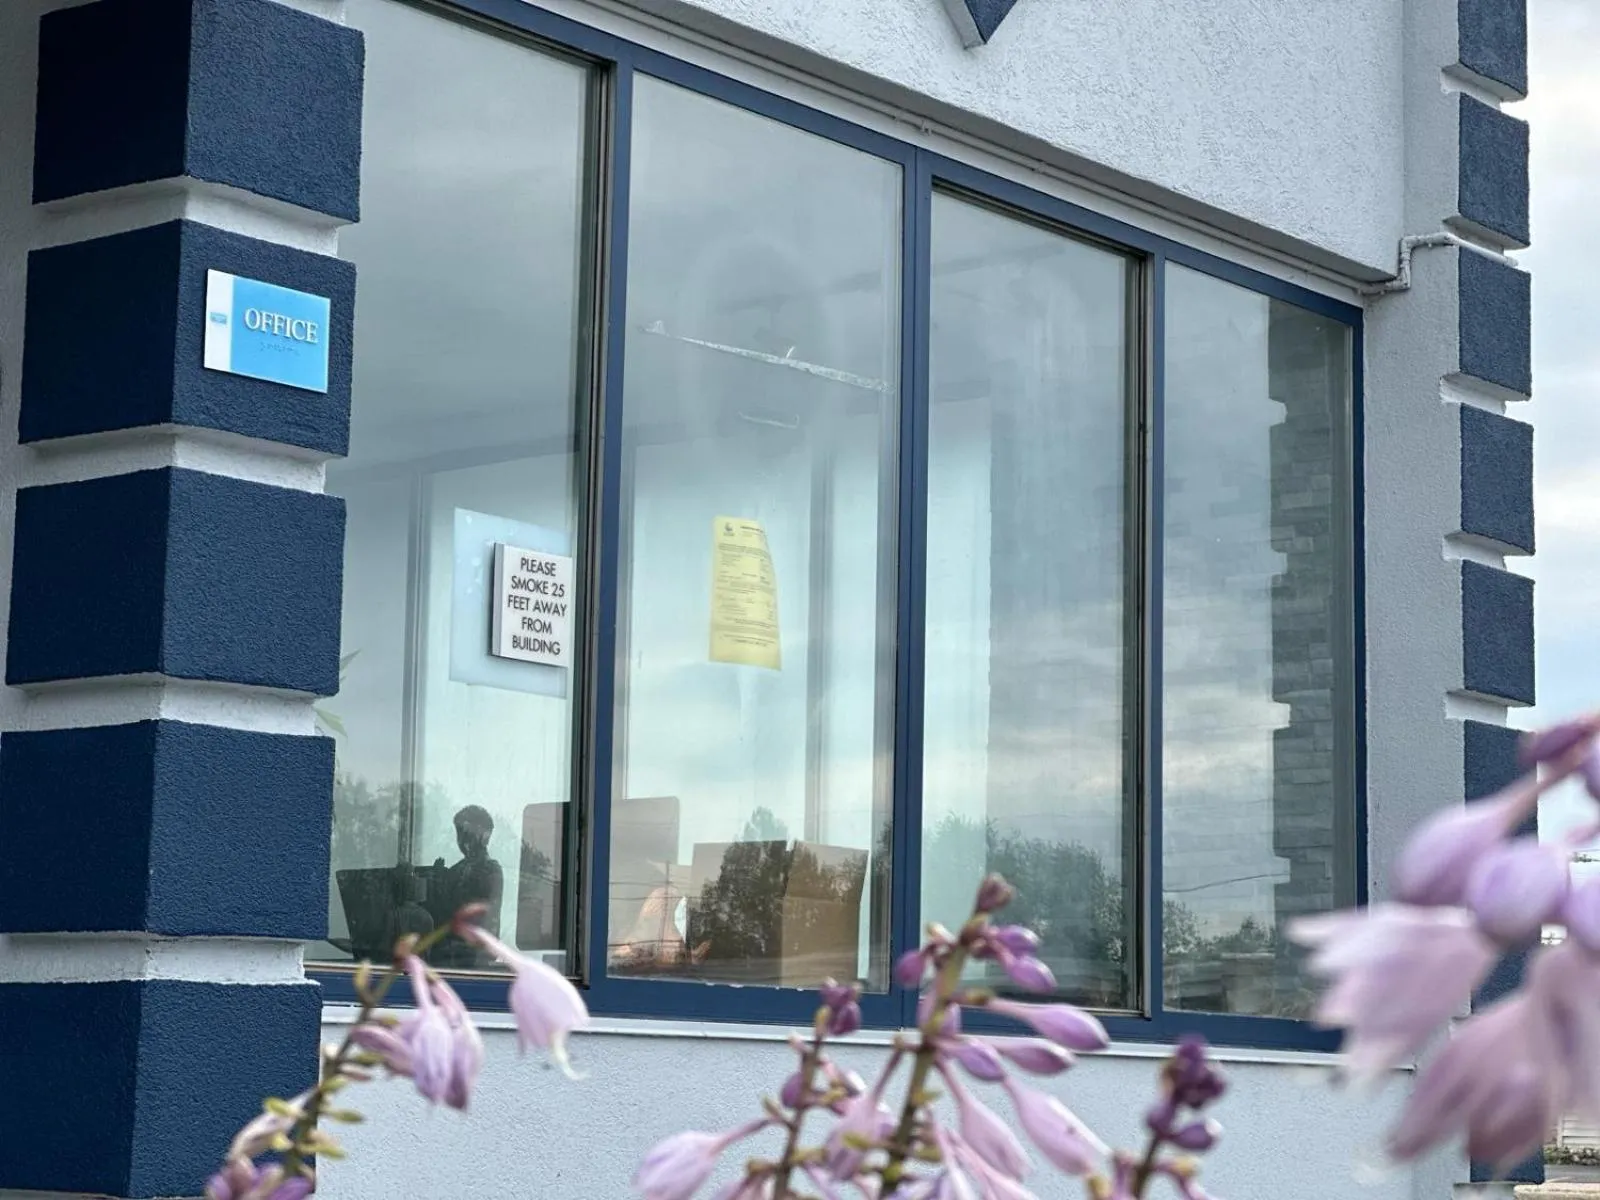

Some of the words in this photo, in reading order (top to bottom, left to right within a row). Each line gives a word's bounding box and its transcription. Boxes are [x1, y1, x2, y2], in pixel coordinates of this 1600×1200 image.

[244, 307, 319, 345] OFFICE
[520, 557, 557, 577] PLEASE
[511, 575, 549, 595] SMOKE
[551, 582, 566, 598] 25
[507, 594, 531, 611] FEET
[532, 600, 567, 617] AWAY
[521, 616, 553, 635] FROM
[512, 635, 561, 656] BUILDING
